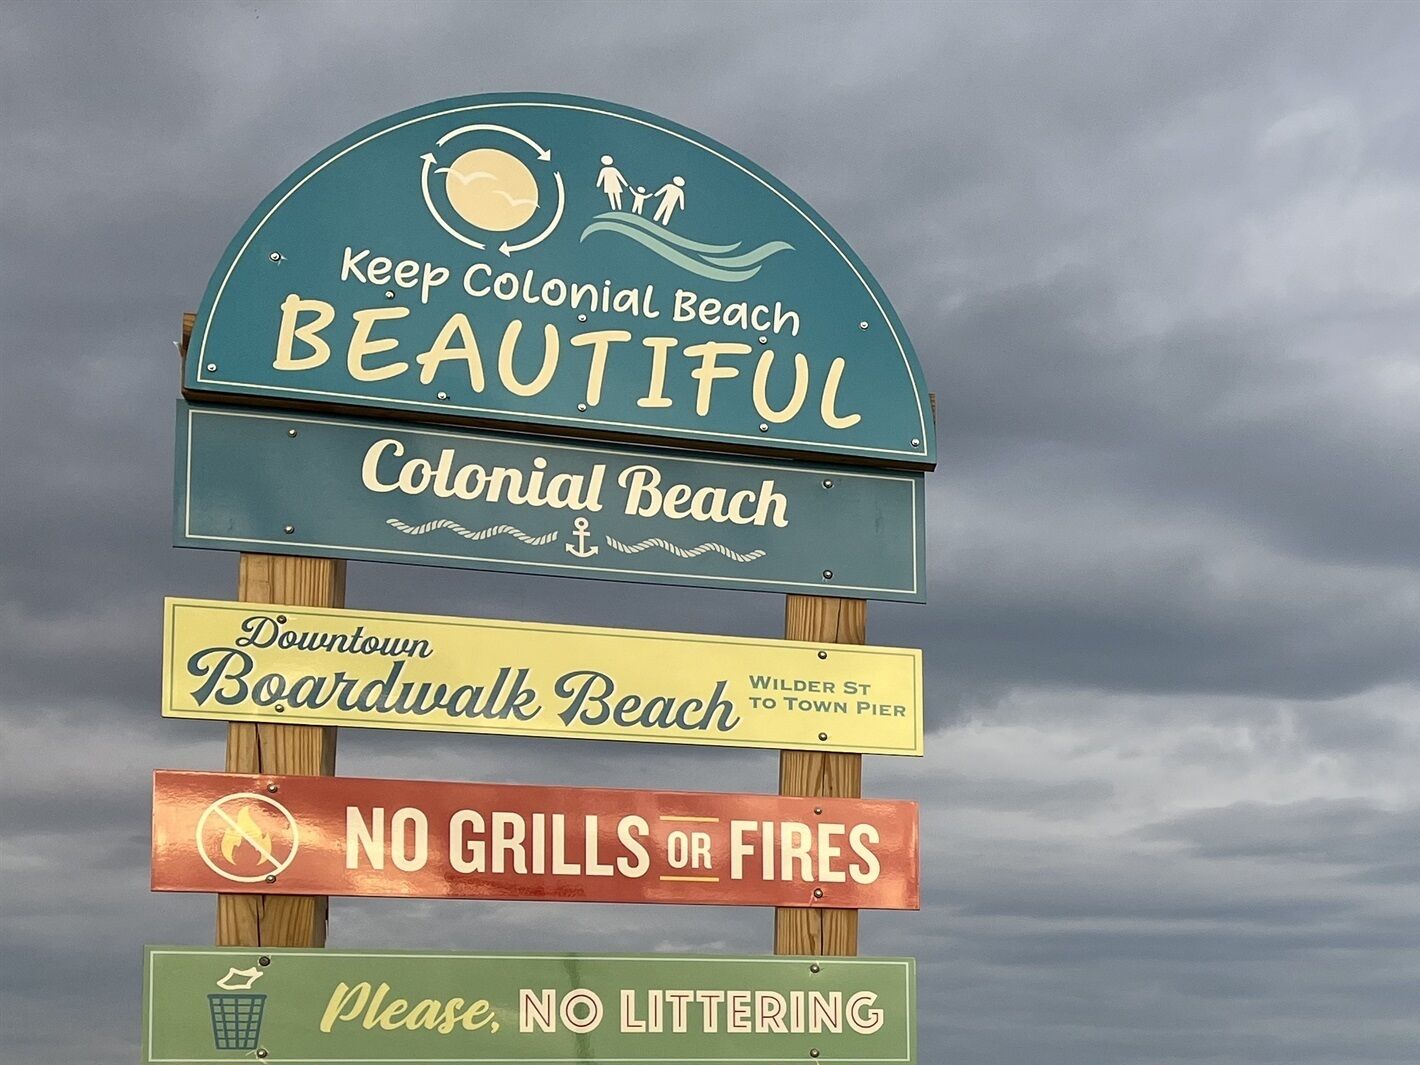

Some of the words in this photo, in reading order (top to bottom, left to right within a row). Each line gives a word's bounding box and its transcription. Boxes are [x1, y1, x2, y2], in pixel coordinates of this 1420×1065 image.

[340, 246, 451, 304] Keep
[462, 262, 658, 320] Colonial
[671, 289, 801, 337] Beach
[272, 294, 862, 430] BEAUTIFUL
[361, 438, 606, 513] Colonial
[617, 464, 789, 528] Beach
[235, 615, 434, 660] Downtown
[187, 646, 543, 723] Boardwalk
[554, 670, 741, 733] Beach
[749, 675, 835, 694] WILDER
[783, 697, 848, 714] TOWN
[856, 701, 907, 717] PIER
[345, 806, 429, 873] NO
[450, 810, 651, 879] GRILLS
[667, 828, 713, 869] OR
[730, 820, 882, 885] FIRES
[319, 982, 502, 1034] Please,
[518, 989, 602, 1034] NO
[618, 989, 885, 1034] LITTERING
